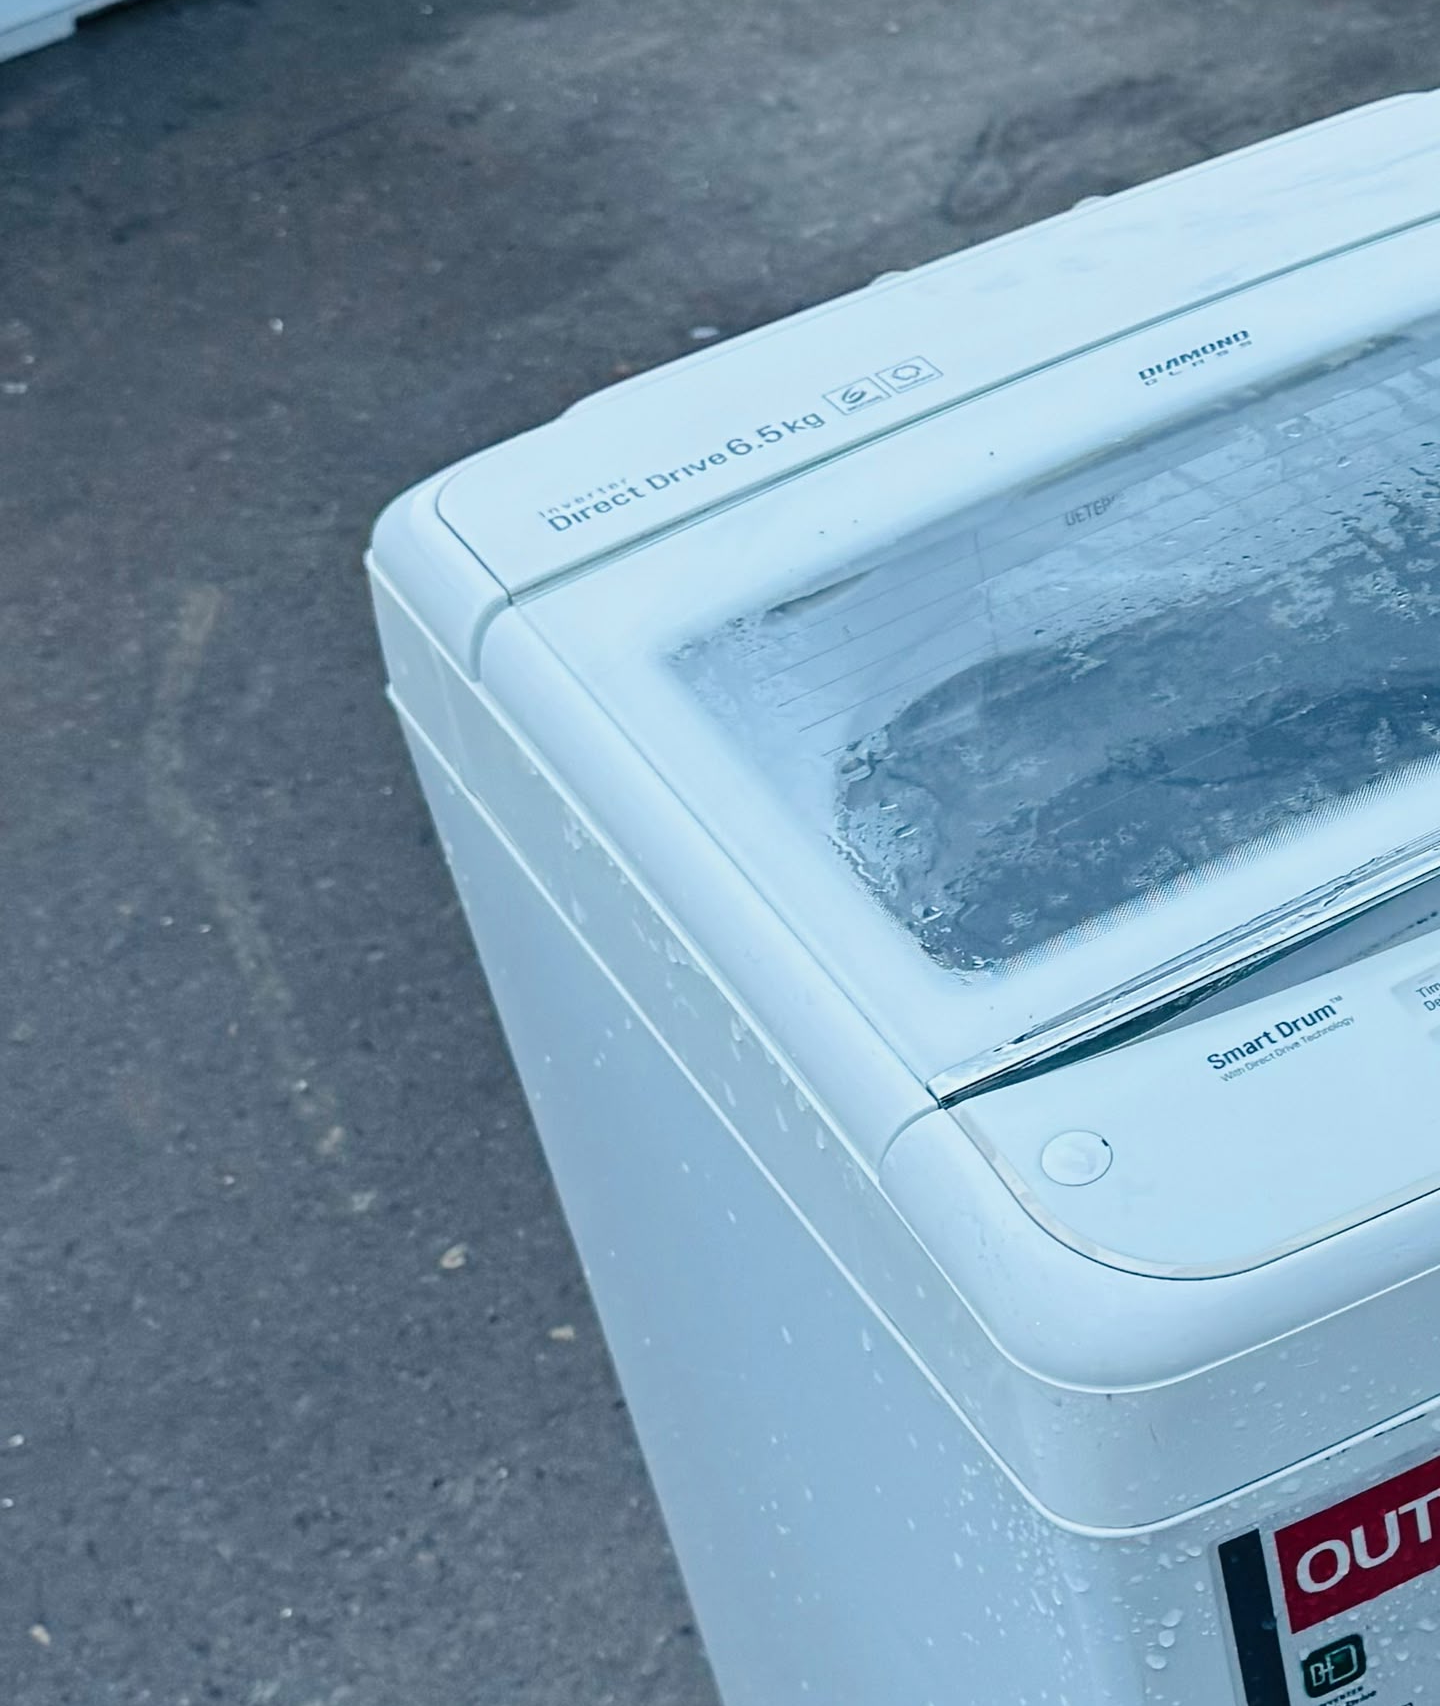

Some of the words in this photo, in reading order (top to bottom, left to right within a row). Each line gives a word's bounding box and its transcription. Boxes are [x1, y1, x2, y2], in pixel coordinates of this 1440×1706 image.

[1138, 330, 1250, 380] DIAMOND
[547, 485, 645, 532] Direct
[645, 452, 727, 491] Drive
[1207, 1032, 1277, 1070] Smart
[1246, 1052, 1276, 1070] Direct
[1275, 1041, 1301, 1057] Drive
[1299, 1016, 1355, 1044] Technology
